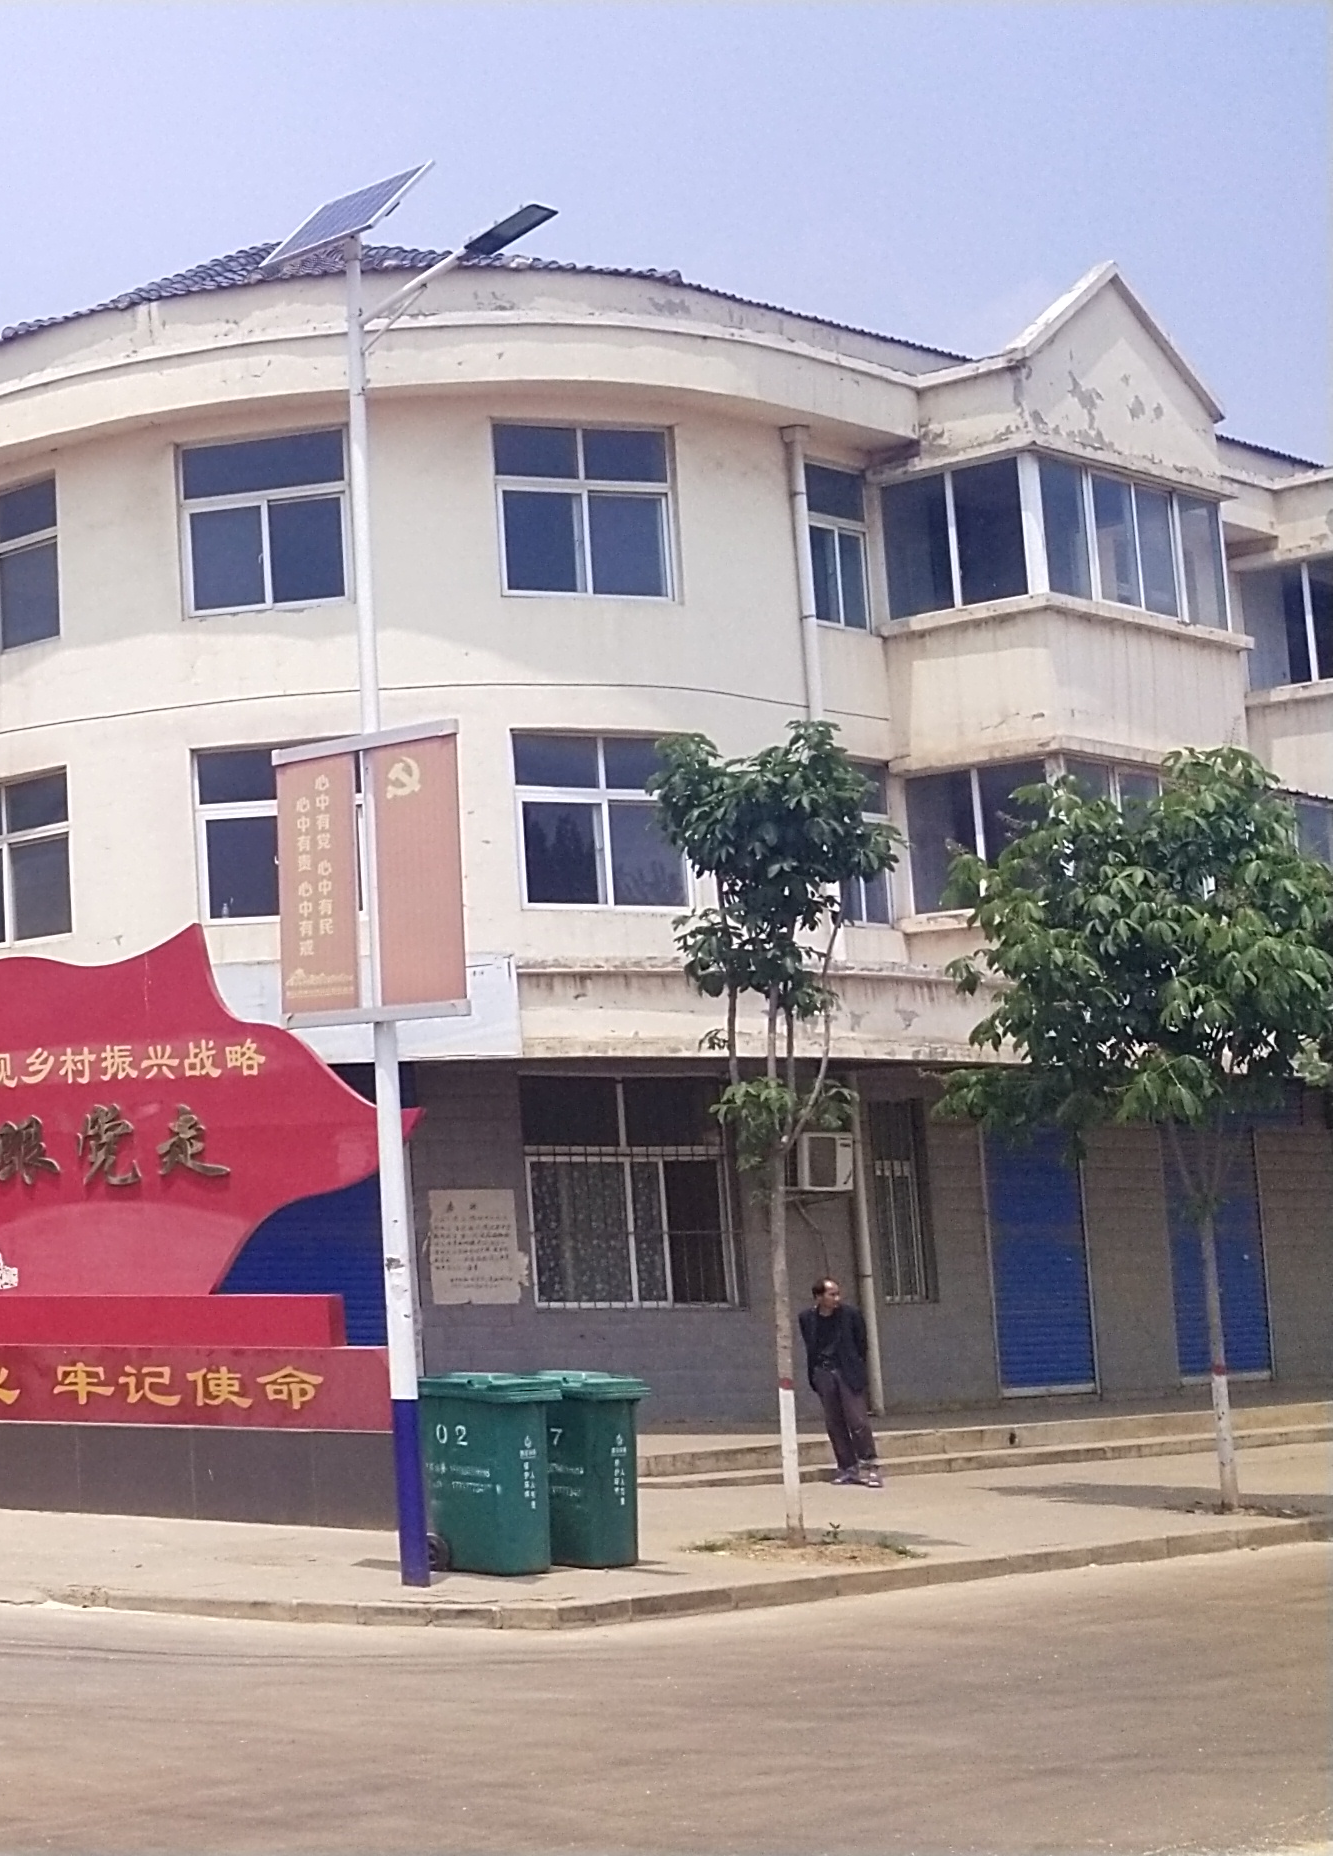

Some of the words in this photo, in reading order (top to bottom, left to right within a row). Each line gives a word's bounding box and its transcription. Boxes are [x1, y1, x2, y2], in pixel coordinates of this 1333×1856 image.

[295, 796, 313, 873] 心中有责
[314, 774, 331, 850] 心中有党
[297, 879, 315, 957] 心中有戒
[317, 859, 333, 936] 心中有民
[52, 1362, 326, 1411] 牢记使命
